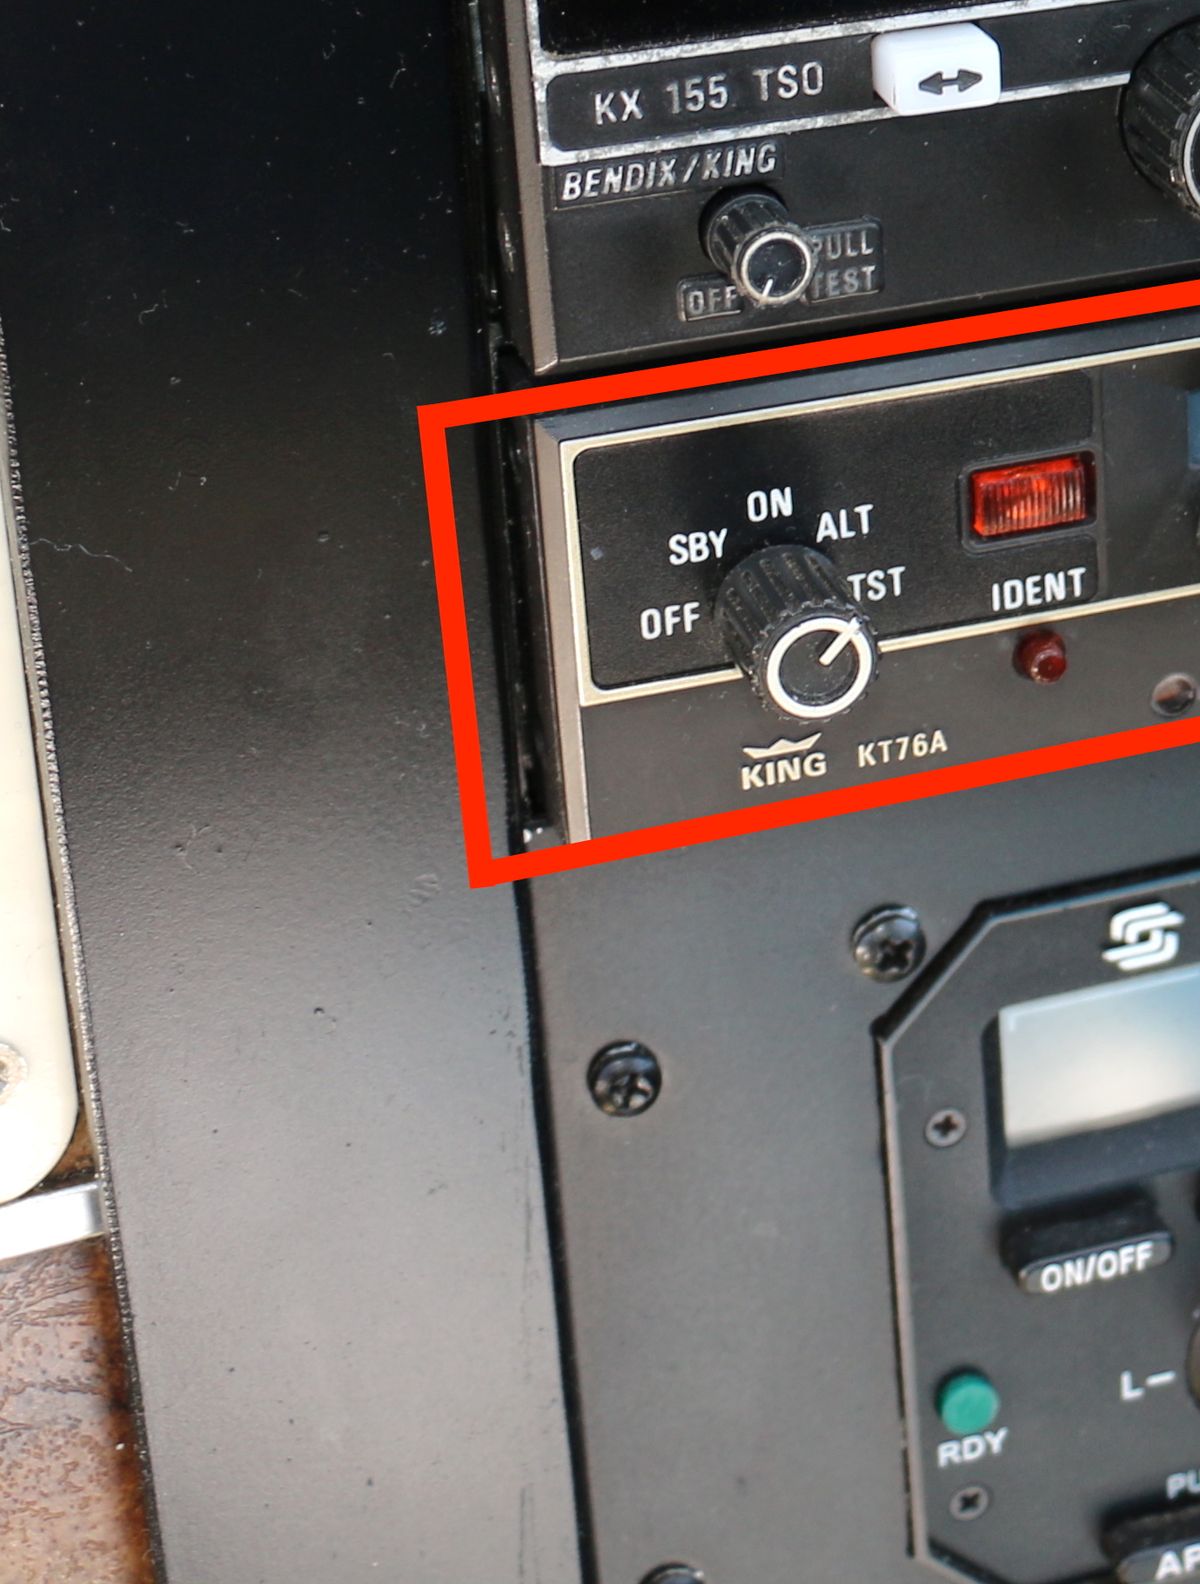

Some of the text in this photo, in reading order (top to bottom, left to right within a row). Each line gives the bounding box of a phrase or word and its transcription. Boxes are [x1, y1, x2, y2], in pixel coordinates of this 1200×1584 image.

[594, 61, 824, 125] KX 155 TSO
[561, 140, 778, 202] BENDIX/KING
[747, 487, 793, 523] ON
[816, 504, 873, 543] ALT
[668, 529, 728, 566] SBY
[847, 566, 906, 602] TST
[992, 567, 1086, 612] IDENT
[640, 601, 700, 640] OFF
[741, 729, 948, 791] KING KT76A
[1040, 1242, 1154, 1293] ON/OFF
[937, 1427, 1009, 1469] RDY
